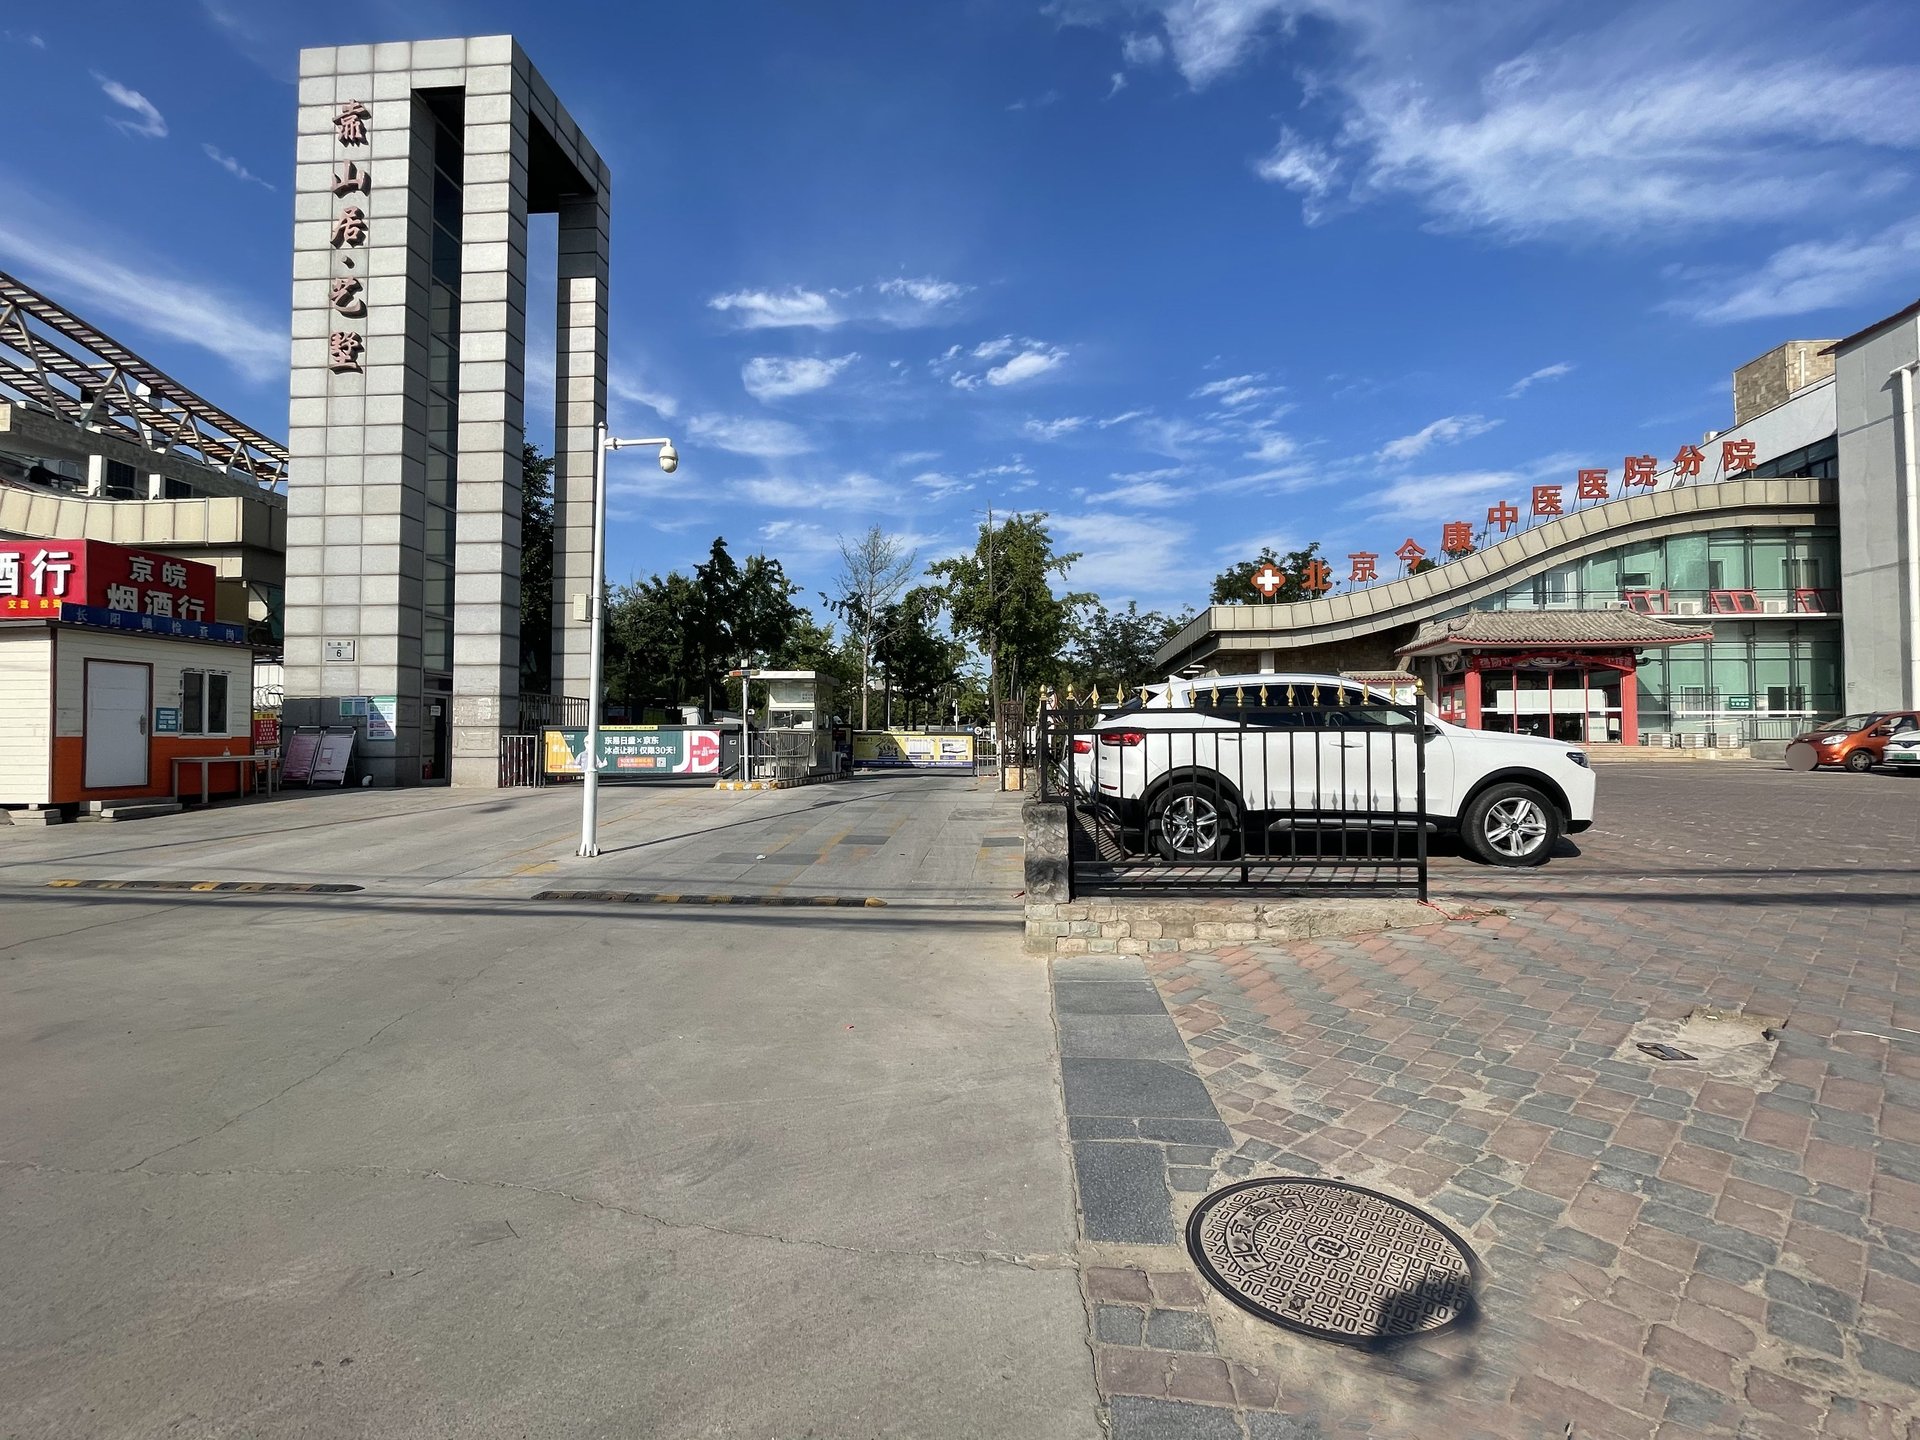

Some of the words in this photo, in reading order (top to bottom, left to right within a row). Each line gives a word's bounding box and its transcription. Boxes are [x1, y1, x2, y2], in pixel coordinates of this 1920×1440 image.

[1302, 438, 1758, 591] 北京今康中医医院分院
[107, 582, 205, 623] 烟酒行
[336, 649, 342, 658] 6
[672, 731, 719, 773] JD
[1385, 1254, 1408, 1284] 2005
